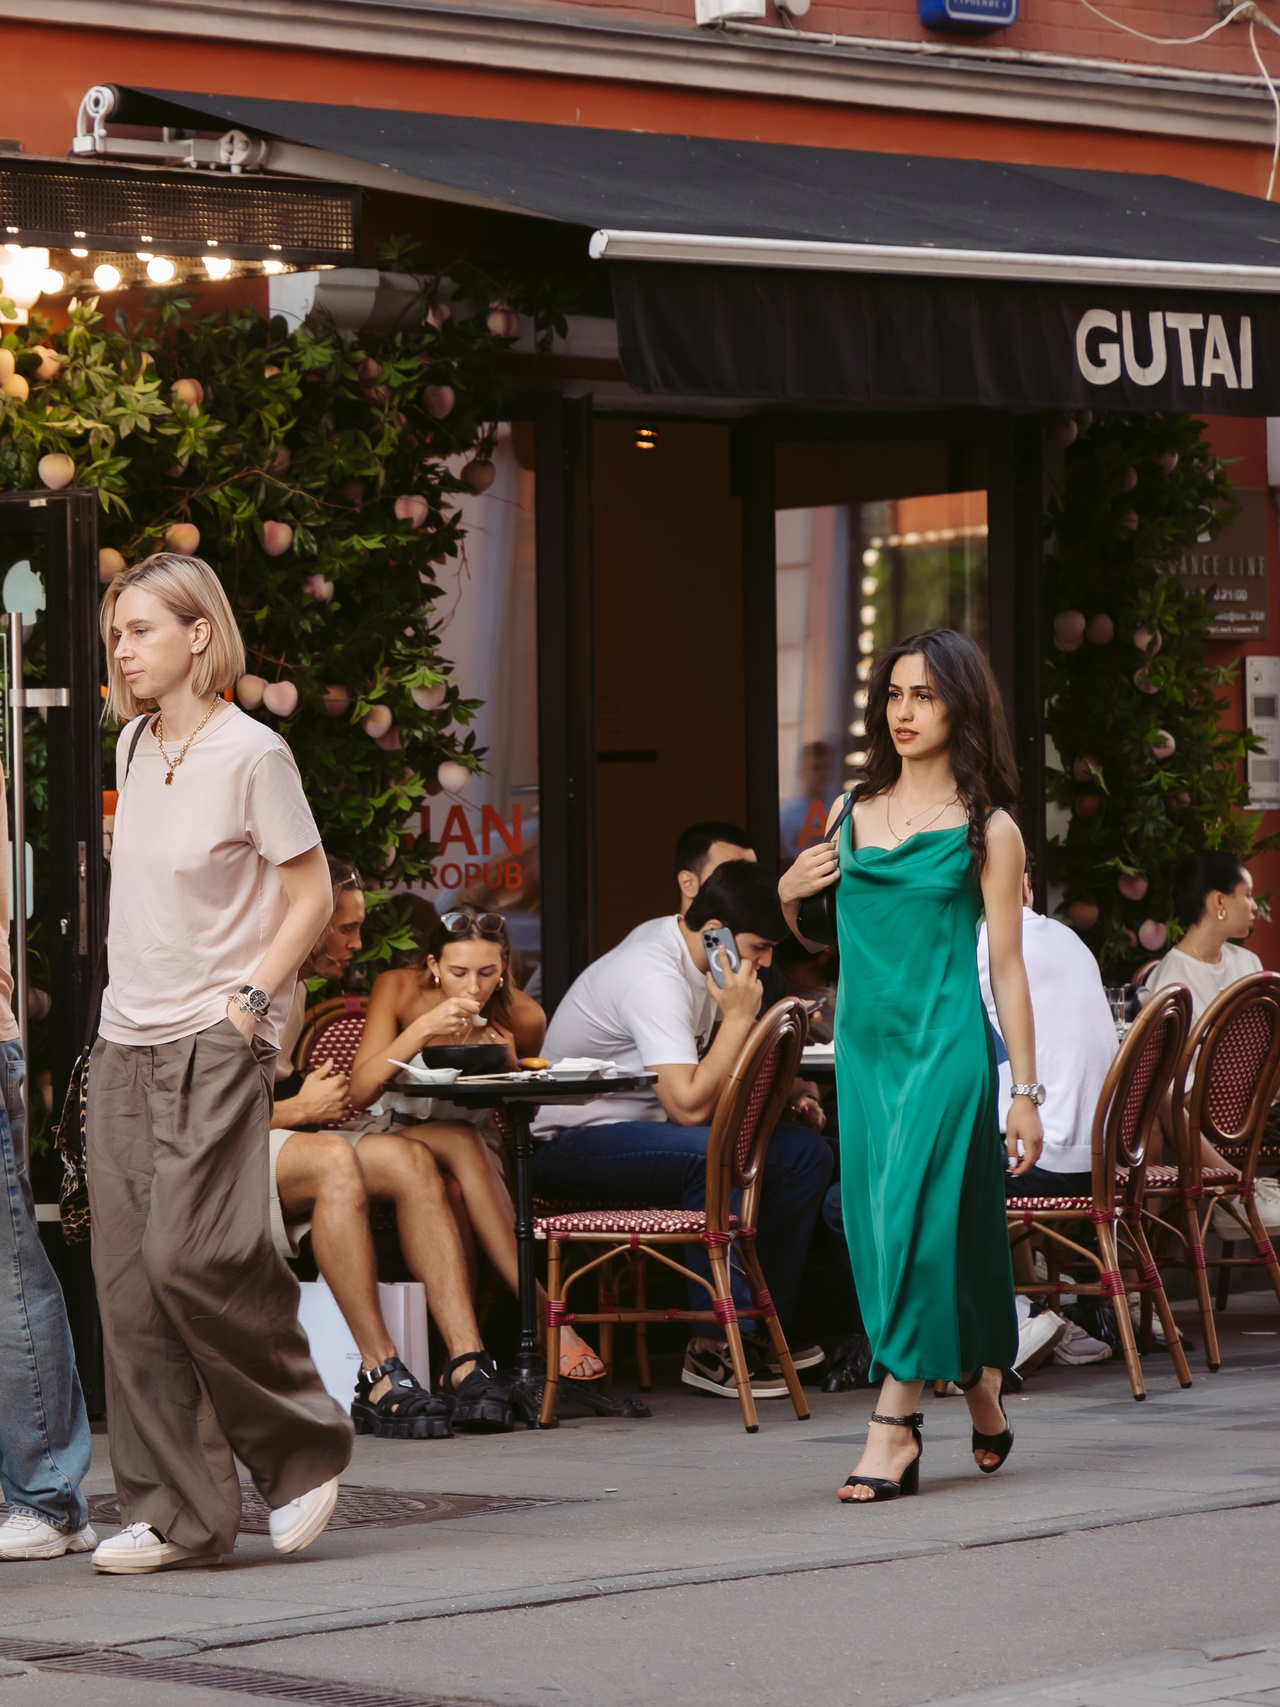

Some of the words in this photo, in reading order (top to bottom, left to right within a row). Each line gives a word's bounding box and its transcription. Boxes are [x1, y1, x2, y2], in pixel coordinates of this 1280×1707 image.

[1076, 309, 1253, 389] GUTAI
[1229, 556, 1266, 577] LINE
[404, 804, 523, 857] IAN
